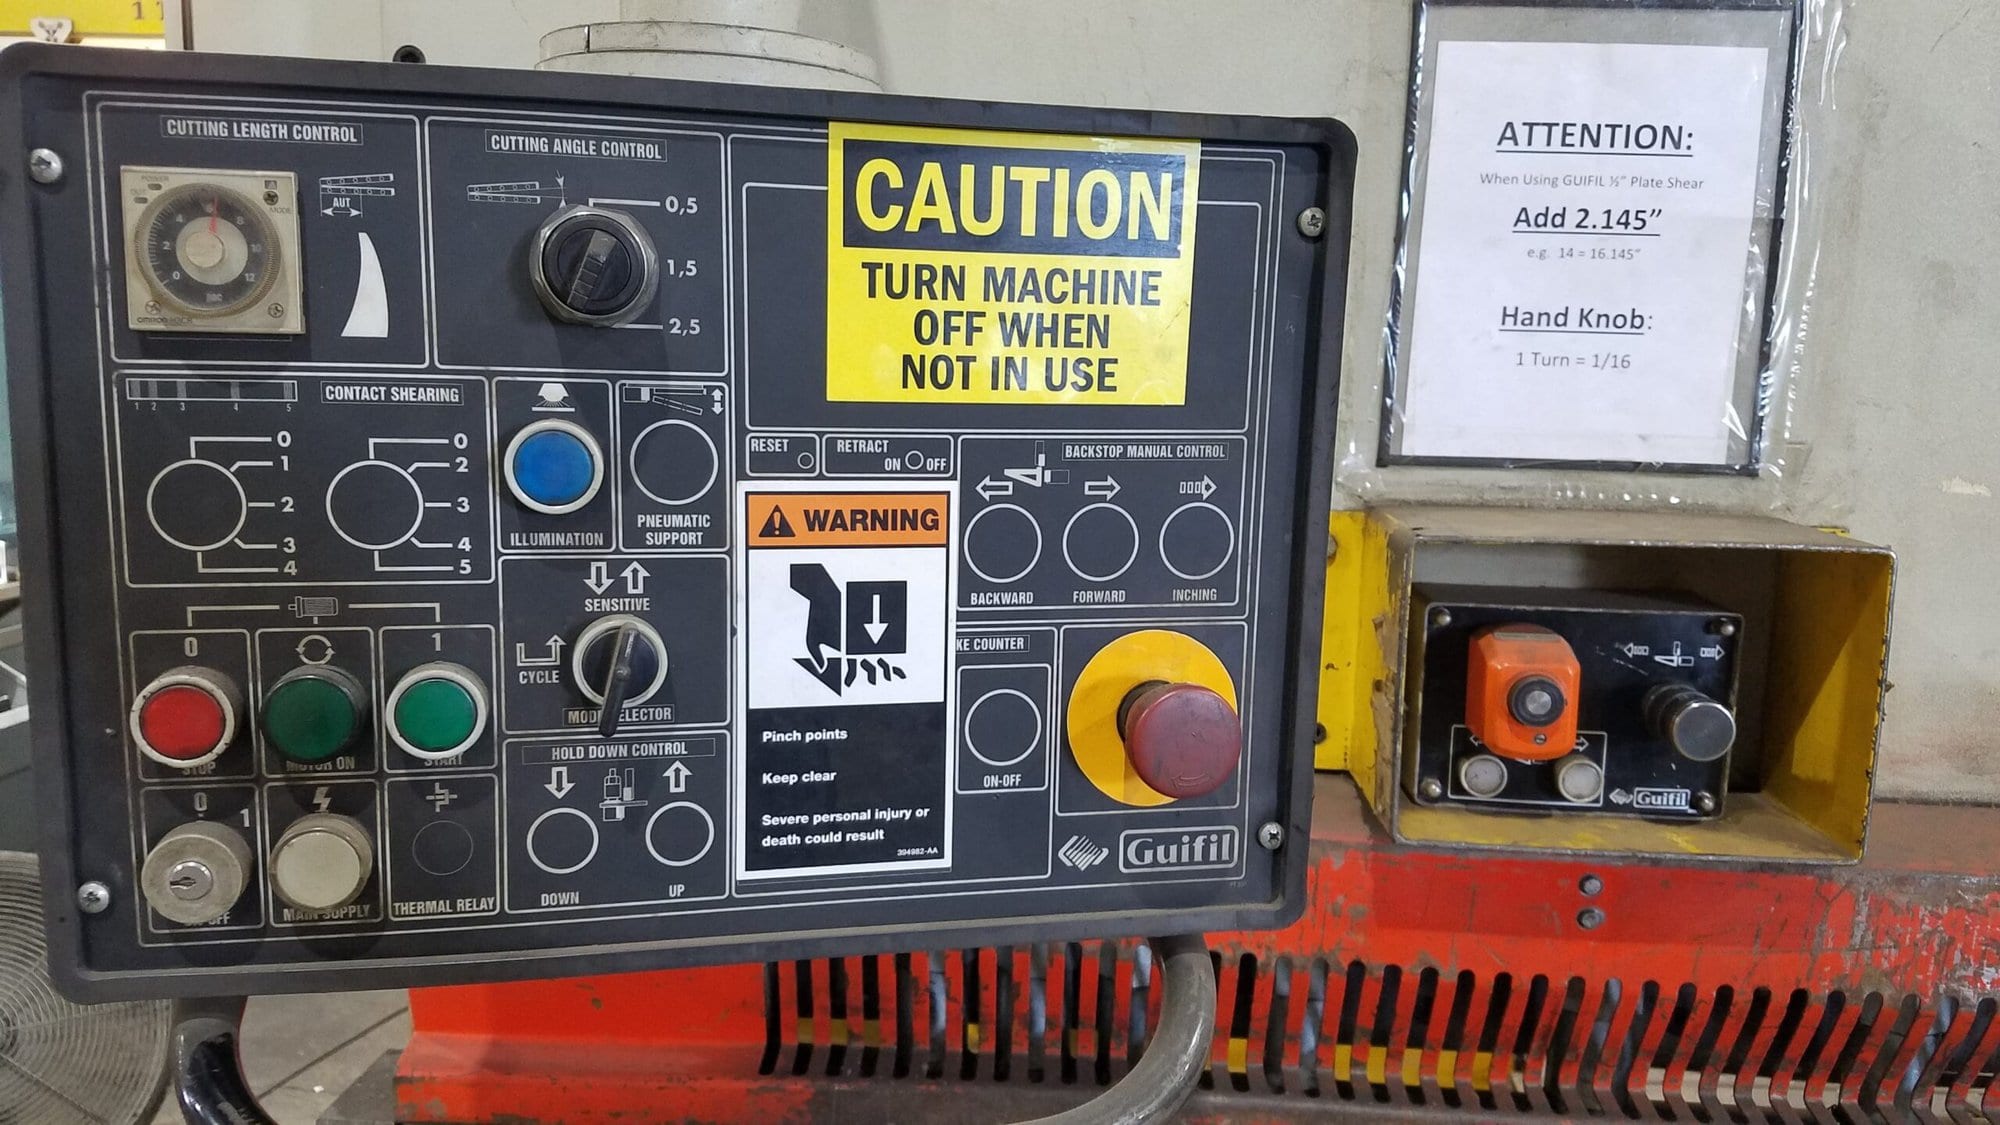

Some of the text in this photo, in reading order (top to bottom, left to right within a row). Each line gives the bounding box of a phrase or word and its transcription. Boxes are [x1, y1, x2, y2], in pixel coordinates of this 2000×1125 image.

[167, 119, 357, 143] CUTTING LENGTH CONTROL
[1496, 121, 1693, 150] ATTENTION:
[491, 135, 662, 160] CUTTING ANGLE CONTROL
[1480, 173, 1519, 185] When
[1523, 174, 1559, 188] Using
[1563, 175, 1605, 187] GUIFIL
[1631, 176, 1663, 189] Plate
[1667, 177, 1704, 190] Shear
[333, 197, 351, 208] AUT
[665, 196, 698, 216] 0,5
[855, 158, 1173, 241] CAUTION
[175, 214, 184, 223] 4
[236, 215, 244, 225] 8
[1513, 206, 1566, 228] Add
[163, 242, 171, 250] 2
[1527, 249, 1550, 260] e.g.
[1559, 248, 1574, 259] 14
[172, 271, 180, 280] 0
[667, 259, 697, 278] 1,5
[245, 273, 255, 282] 12
[861, 261, 1162, 306] TURN MACHINE
[1501, 305, 1653, 330] Hand Knob:
[669, 318, 700, 336] 2,5
[914, 309, 1110, 349] OFF WHEN
[1516, 352, 1524, 366] 1
[1531, 352, 1570, 367] Turn
[1591, 353, 1631, 370] 1/16
[901, 354, 1119, 392] NOT IN USE
[325, 385, 459, 402] CONTACT SHEARING
[151, 402, 157, 411] 2
[180, 402, 186, 411] 3
[233, 403, 239, 411] 4
[286, 403, 292, 412] 5
[277, 431, 292, 447] 0
[453, 433, 468, 449] 0
[751, 439, 789, 452] RESET
[837, 440, 889, 453] RETRACT
[1065, 445, 1225, 458] BACKSTOP MANUAL CONTROL
[281, 456, 289, 471] 1
[456, 457, 469, 472] 2
[884, 458, 947, 471] ON OFF
[281, 497, 295, 513] 2
[457, 497, 470, 513] 3
[637, 514, 711, 528] PNEUMATIC
[803, 507, 940, 532] WARNING
[283, 537, 296, 553] 3
[457, 537, 472, 552] 4
[510, 533, 604, 547] ILLUMINATION
[645, 532, 703, 546] SUPPORT
[283, 561, 298, 576] 4
[459, 560, 472, 574] 5
[970, 592, 1034, 606] BACKWARD
[1073, 590, 1126, 604] FORWARD
[1172, 588, 1217, 602] INCHING
[584, 598, 650, 612] SENSITIVE
[184, 636, 198, 657] 0
[431, 632, 441, 651] 1
[973, 637, 1024, 650] COUNTER
[519, 670, 560, 684] CYCLE
[568, 707, 671, 724] MOD ELECTOR
[762, 728, 848, 743] Pinch points
[552, 742, 688, 760] HOLD DOWN CONTROL
[336, 756, 355, 770] ON
[762, 770, 837, 785] Keep clear
[984, 774, 1021, 788] ON-OFF
[194, 792, 208, 811] 0
[1637, 791, 1686, 806] Guifil
[240, 808, 250, 827] 1
[762, 807, 930, 826] Severe personal injury or
[762, 828, 885, 847] death could result
[1127, 833, 1231, 866] Guifil
[669, 884, 685, 897] UP
[393, 896, 495, 916] THERMAL RELAY
[540, 892, 580, 906] DOWN
[322, 904, 370, 919] SUPPLY
